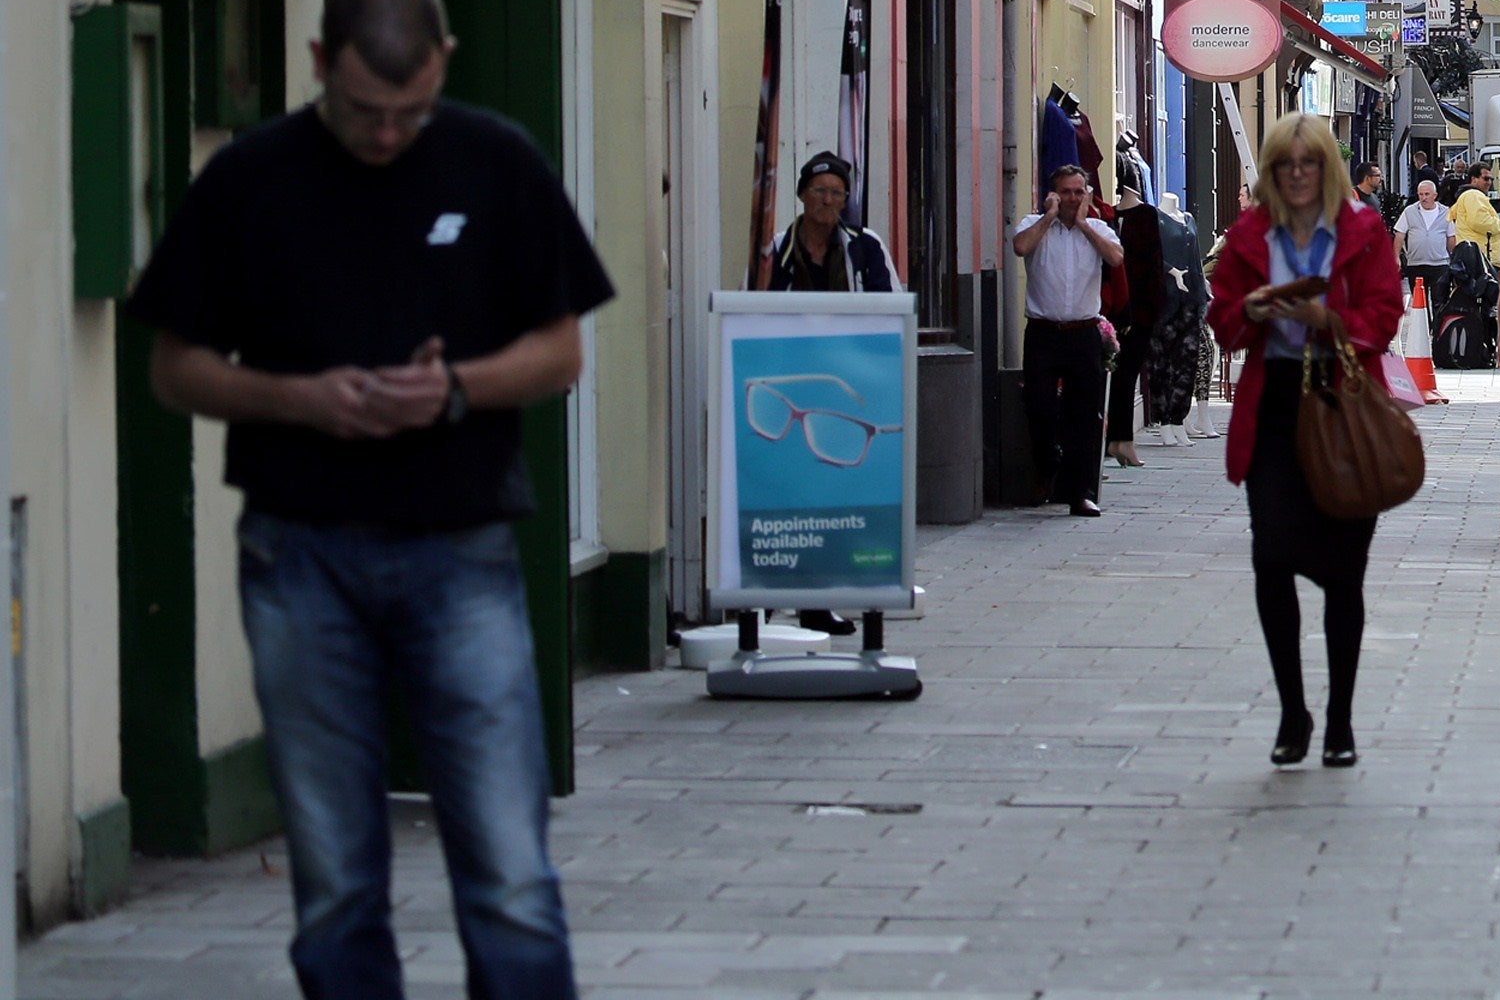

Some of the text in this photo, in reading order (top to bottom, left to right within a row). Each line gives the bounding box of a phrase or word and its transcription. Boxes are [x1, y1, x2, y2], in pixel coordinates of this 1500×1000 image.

[1379, 10, 1400, 20] DELI
[1191, 24, 1250, 35] moderne
[1192, 38, 1250, 48] dancewear
[752, 515, 866, 536] Appointments
[752, 533, 825, 550] available
[752, 551, 799, 569] today
